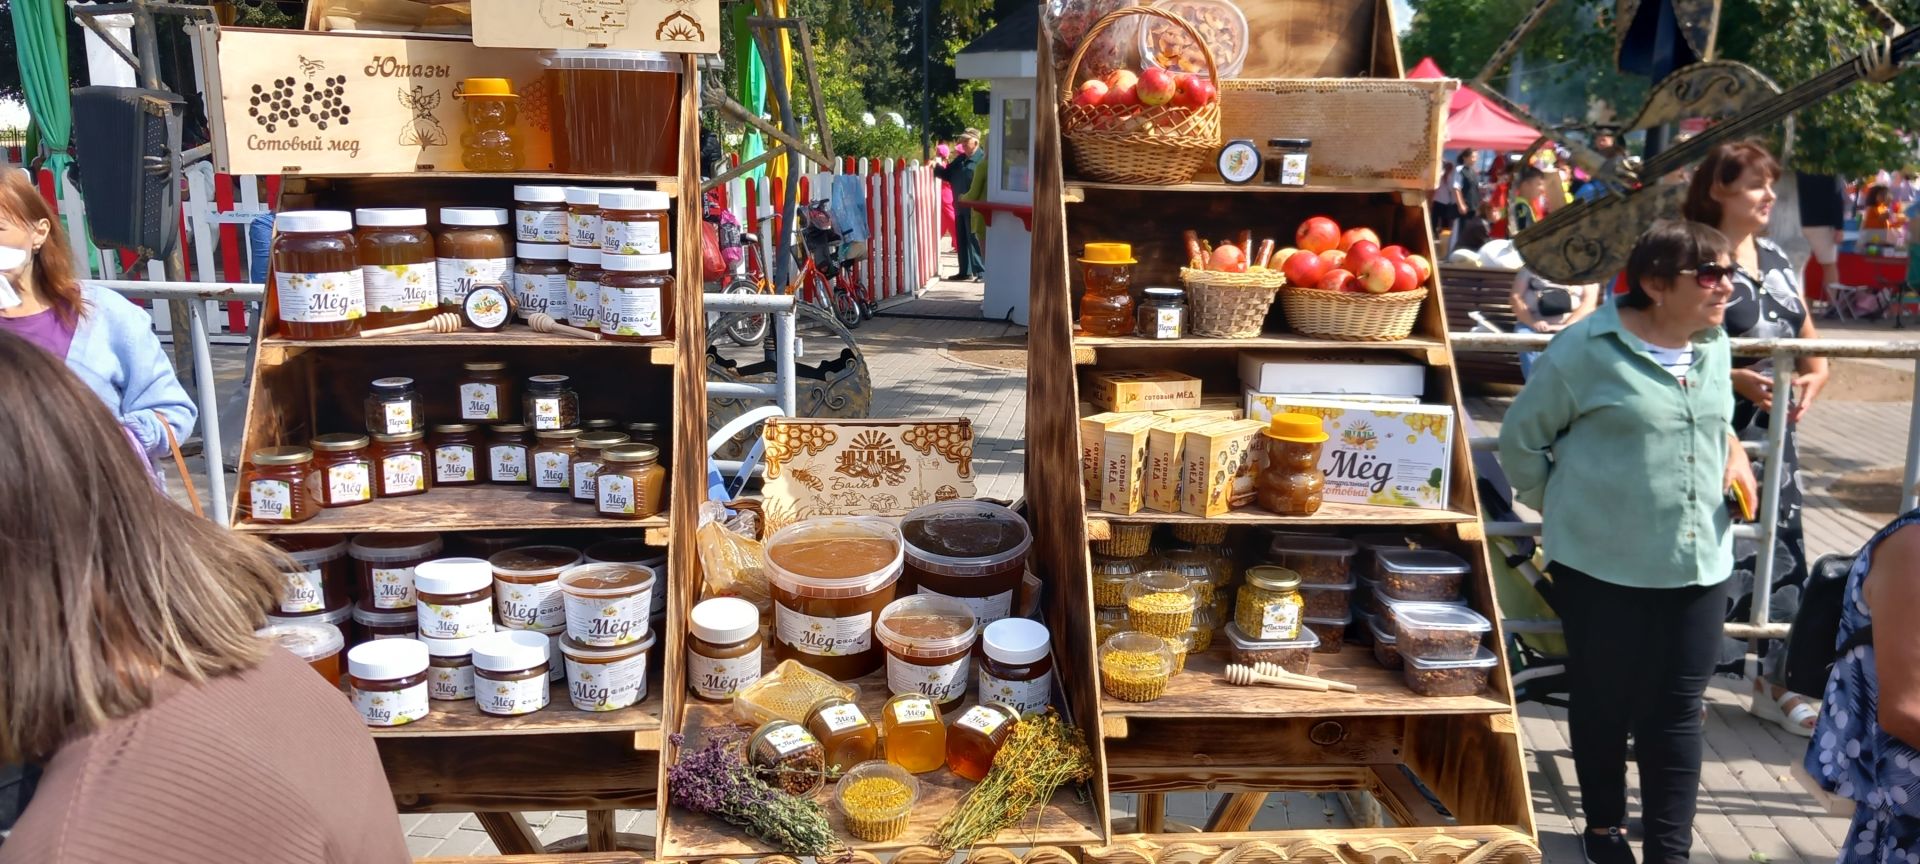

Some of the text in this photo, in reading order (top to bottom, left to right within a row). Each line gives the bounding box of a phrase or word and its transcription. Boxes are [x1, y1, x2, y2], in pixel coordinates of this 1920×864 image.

[364, 56, 450, 78] Ютазы
[247, 134, 361, 158] Сотовый мед
[521, 225, 538, 238] Мёд
[576, 230, 595, 243] Мёд
[402, 288, 427, 303] Мёд
[520, 292, 548, 313] Мёд
[309, 294, 348, 316] Мёд
[572, 304, 594, 320] Мёд
[469, 401, 490, 414] Мёд
[842, 450, 900, 465] ЮТАЗЫ
[444, 463, 466, 477] Мёд
[499, 463, 519, 476] Мёд
[543, 469, 563, 482] Мёд
[1323, 450, 1393, 493] Мёд
[393, 474, 415, 486] Мёд
[581, 480, 595, 491] Мё
[339, 482, 361, 495] Мёд
[259, 499, 282, 514] Мёд
[606, 494, 627, 508] Мёд
[380, 584, 408, 599] Мёд
[503, 601, 538, 625] Мёд
[436, 621, 459, 635] Мёд
[589, 619, 630, 640] Мёд
[800, 631, 835, 652] Мёд
[435, 682, 457, 696] Мёд
[702, 674, 738, 694] Мёд
[919, 682, 950, 699] Мёд
[574, 681, 609, 706] Мёд
[492, 696, 515, 711] Мёд
[367, 707, 390, 722] Мёд
